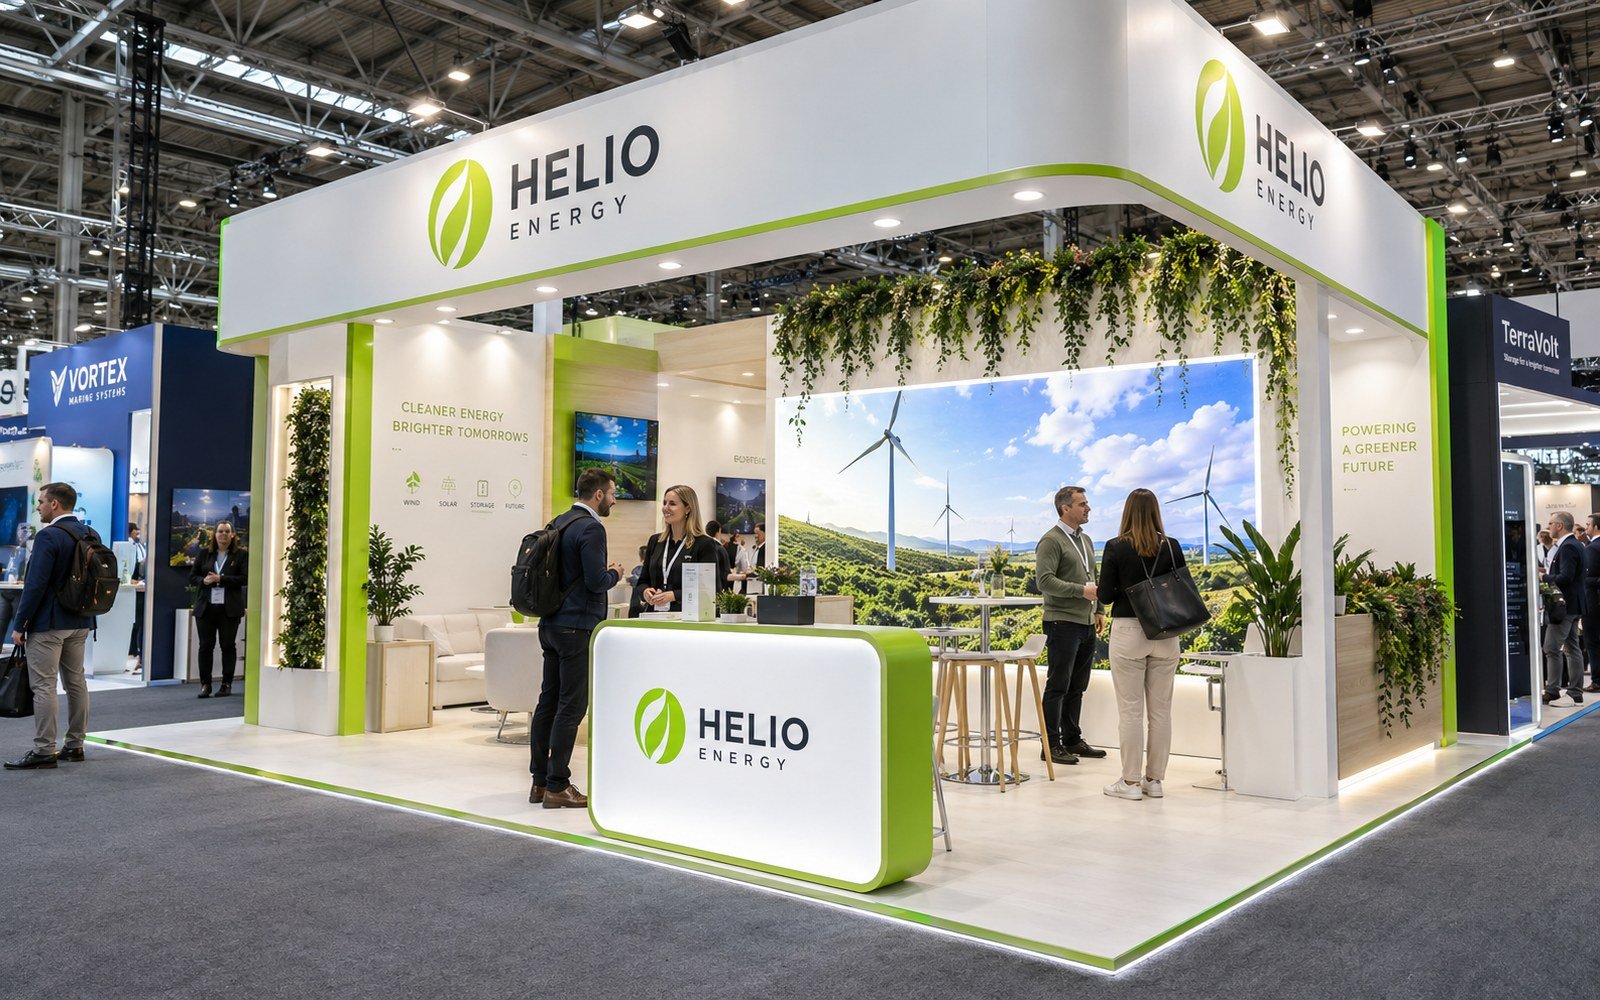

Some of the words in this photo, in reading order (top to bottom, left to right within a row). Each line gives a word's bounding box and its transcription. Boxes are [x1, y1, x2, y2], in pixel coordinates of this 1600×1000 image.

[511, 124, 660, 210] HELIO
[1256, 114, 1325, 207] HELIO
[510, 194, 627, 240] ENERGY
[1257, 178, 1314, 230] ENERGY
[1501, 319, 1559, 359] TerraVolt
[69, 356, 128, 392] VORTEX
[401, 401, 456, 418] CLEANER
[460, 408, 504, 423] ENERGY
[1342, 422, 1416, 437] POWERING
[392, 420, 453, 437] BRIGHTER
[458, 426, 529, 443] TOMORROWS
[1342, 445, 1351, 455] A
[1355, 441, 1417, 454] GREENER
[1343, 461, 1394, 473] FUTURE
[699, 708, 809, 751] HELIO
[699, 747, 786, 771] ENERGY
